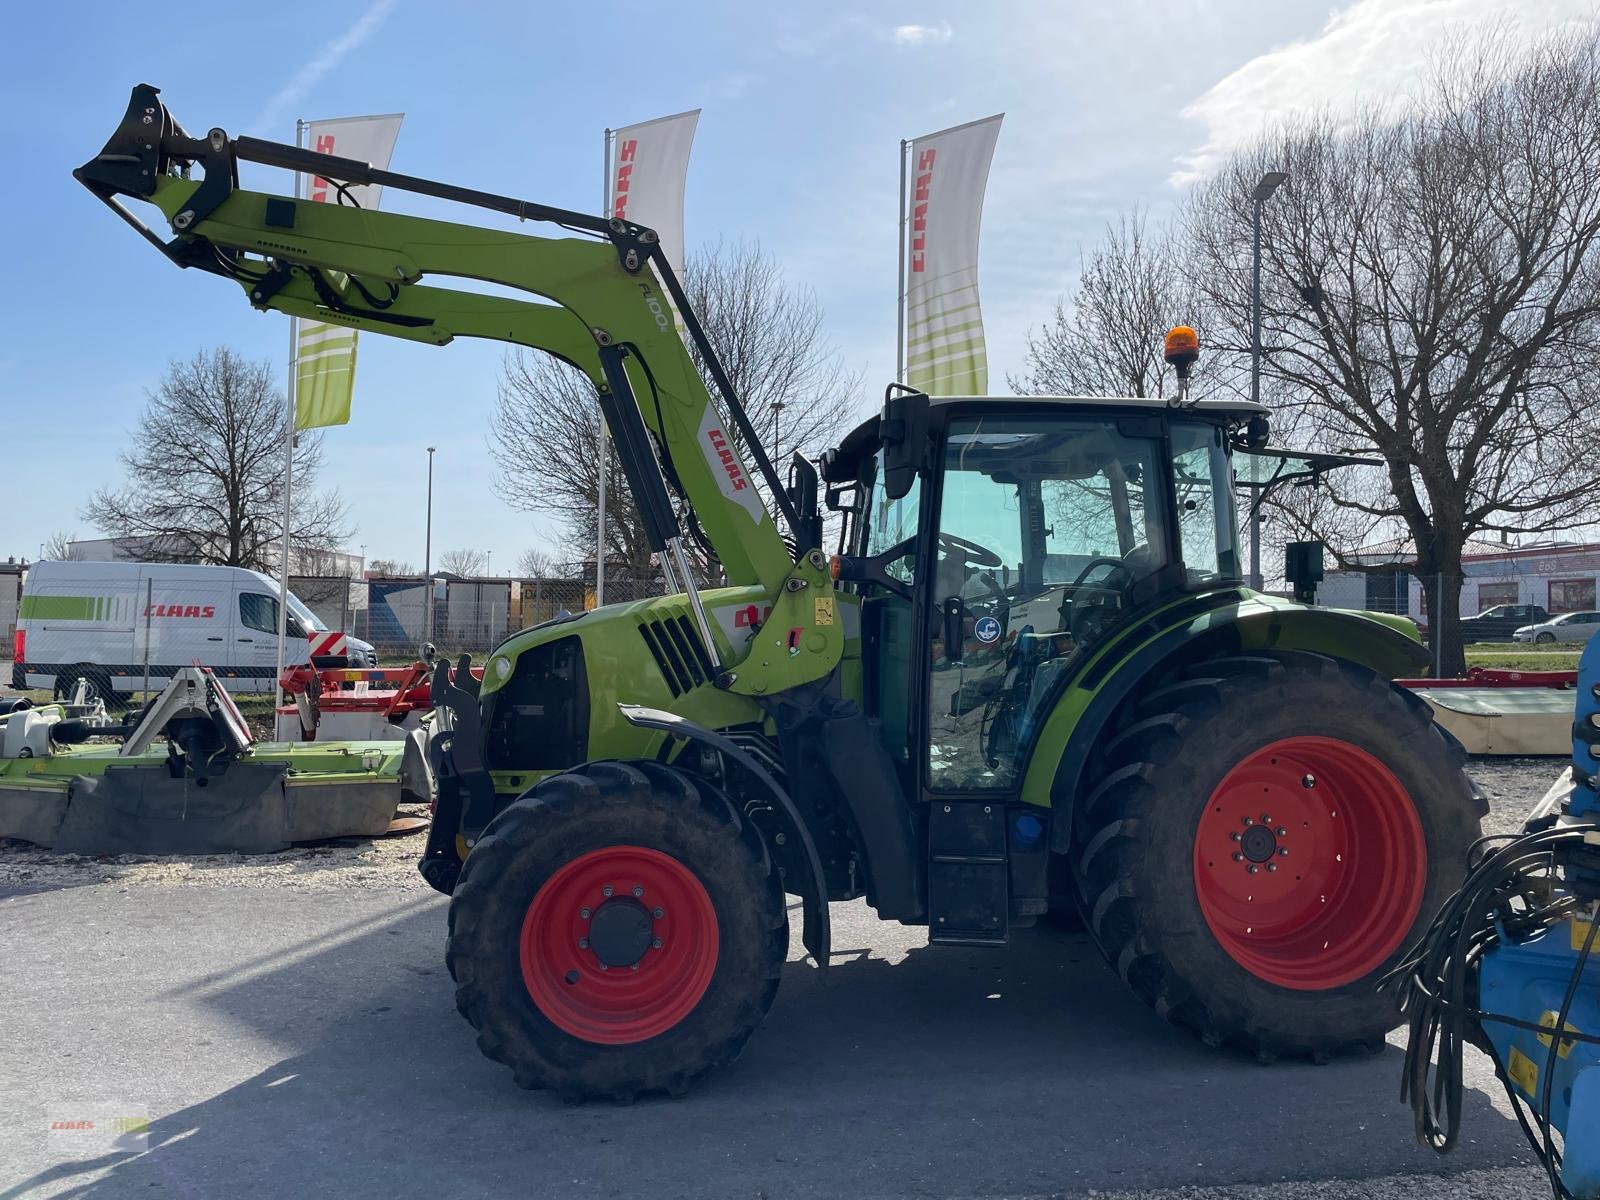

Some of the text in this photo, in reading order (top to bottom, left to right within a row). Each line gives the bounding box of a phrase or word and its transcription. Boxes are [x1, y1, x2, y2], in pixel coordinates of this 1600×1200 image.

[615, 140, 637, 219] AAS
[913, 148, 936, 273] CLAAS
[707, 430, 748, 491] CLAAS
[144, 604, 215, 618] CLAAS
